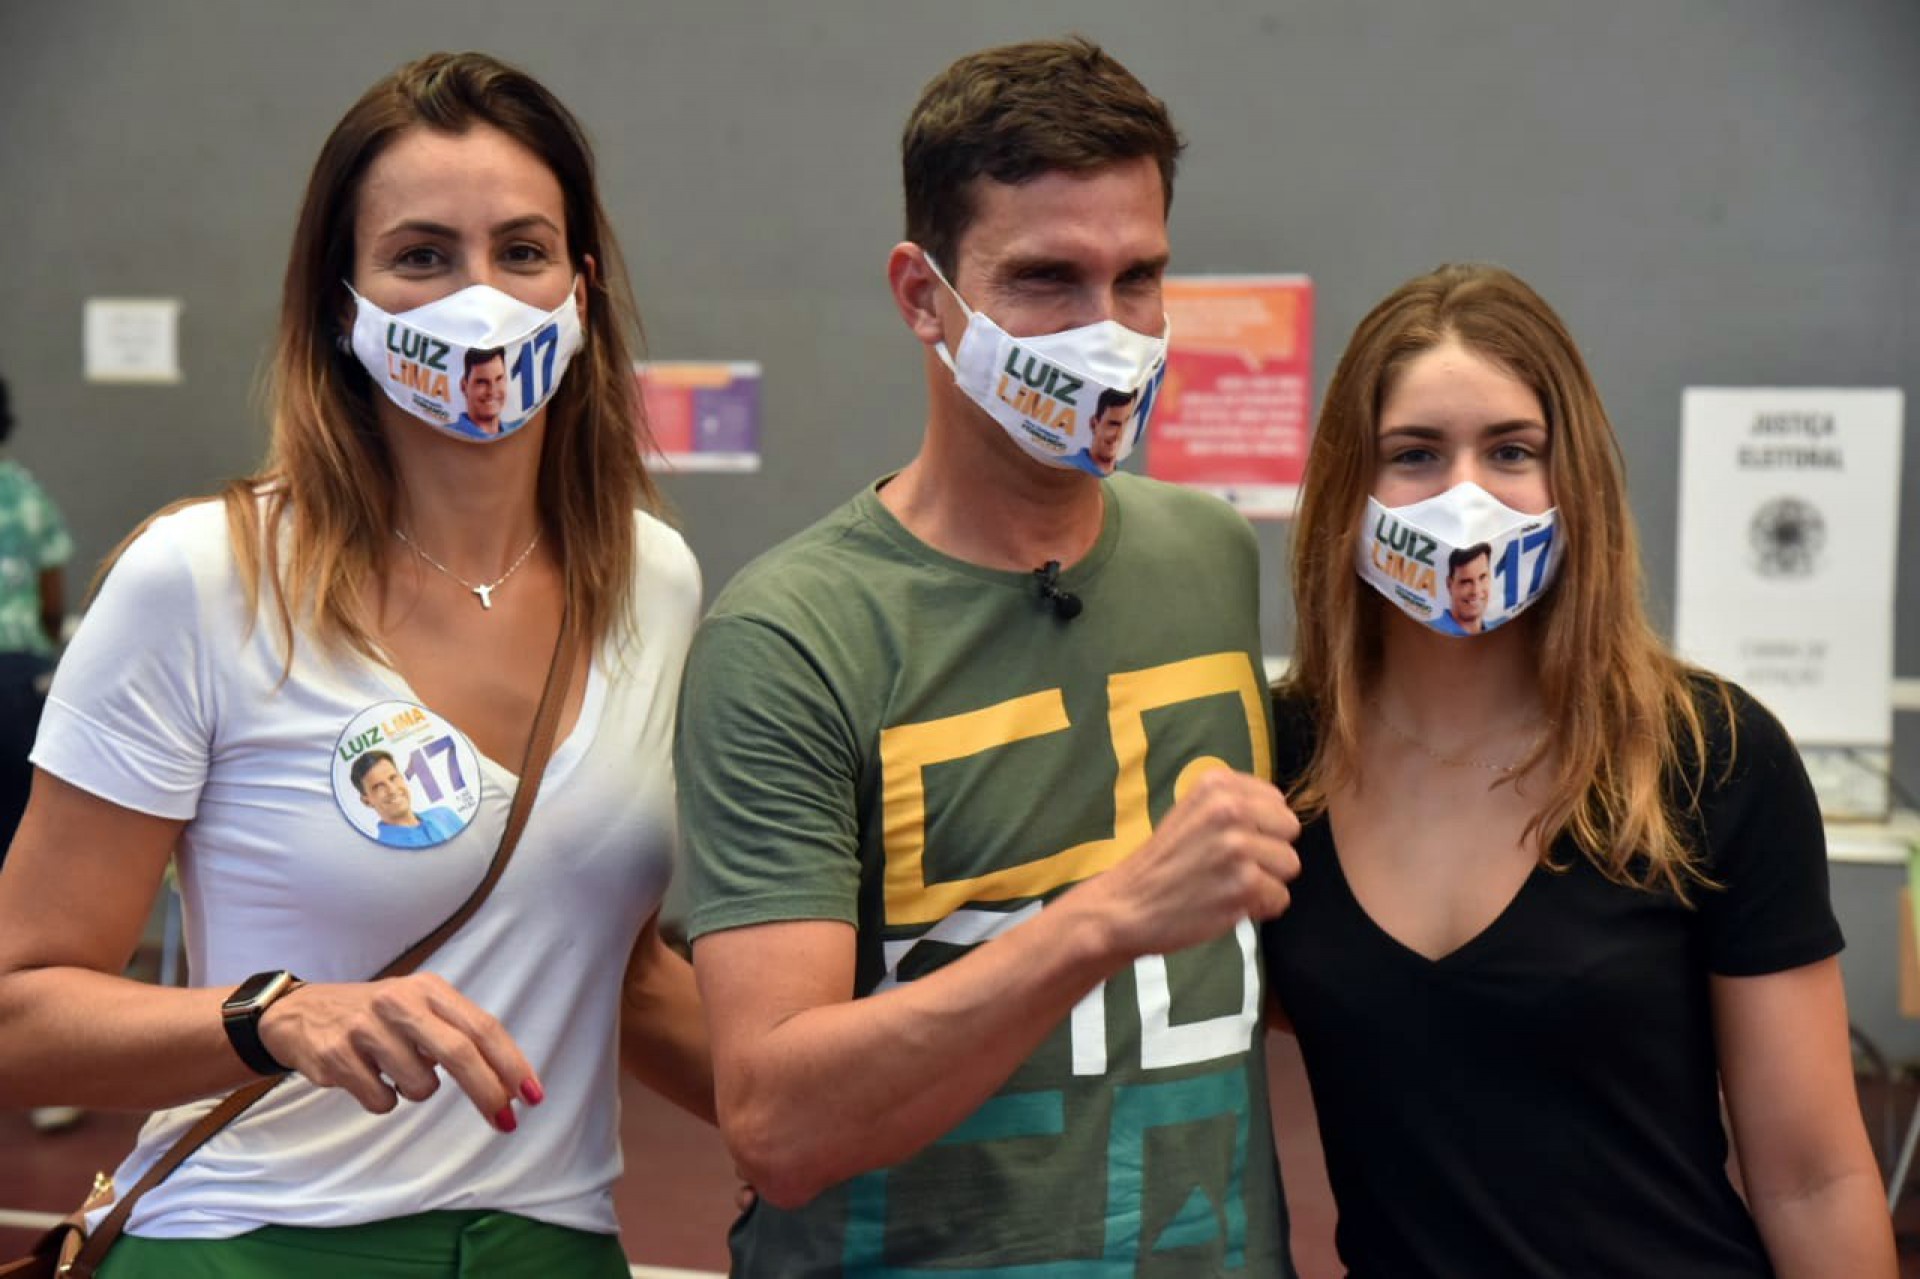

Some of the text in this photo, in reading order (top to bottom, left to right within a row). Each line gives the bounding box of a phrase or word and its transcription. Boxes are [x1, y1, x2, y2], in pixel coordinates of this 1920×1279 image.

[387, 322, 450, 371] LUIZ
[510, 323, 559, 412] 17
[1004, 346, 1084, 406] LUIZ
[387, 351, 451, 403] LIMA
[996, 373, 1077, 437] LIMA
[1372, 539, 1438, 599] LIMA
[1375, 513, 1437, 566] LUIZ
[1494, 523, 1555, 609] 17
[338, 726, 384, 761] LUIZ
[382, 706, 427, 738] LIMA
[405, 735, 467, 803] 17
